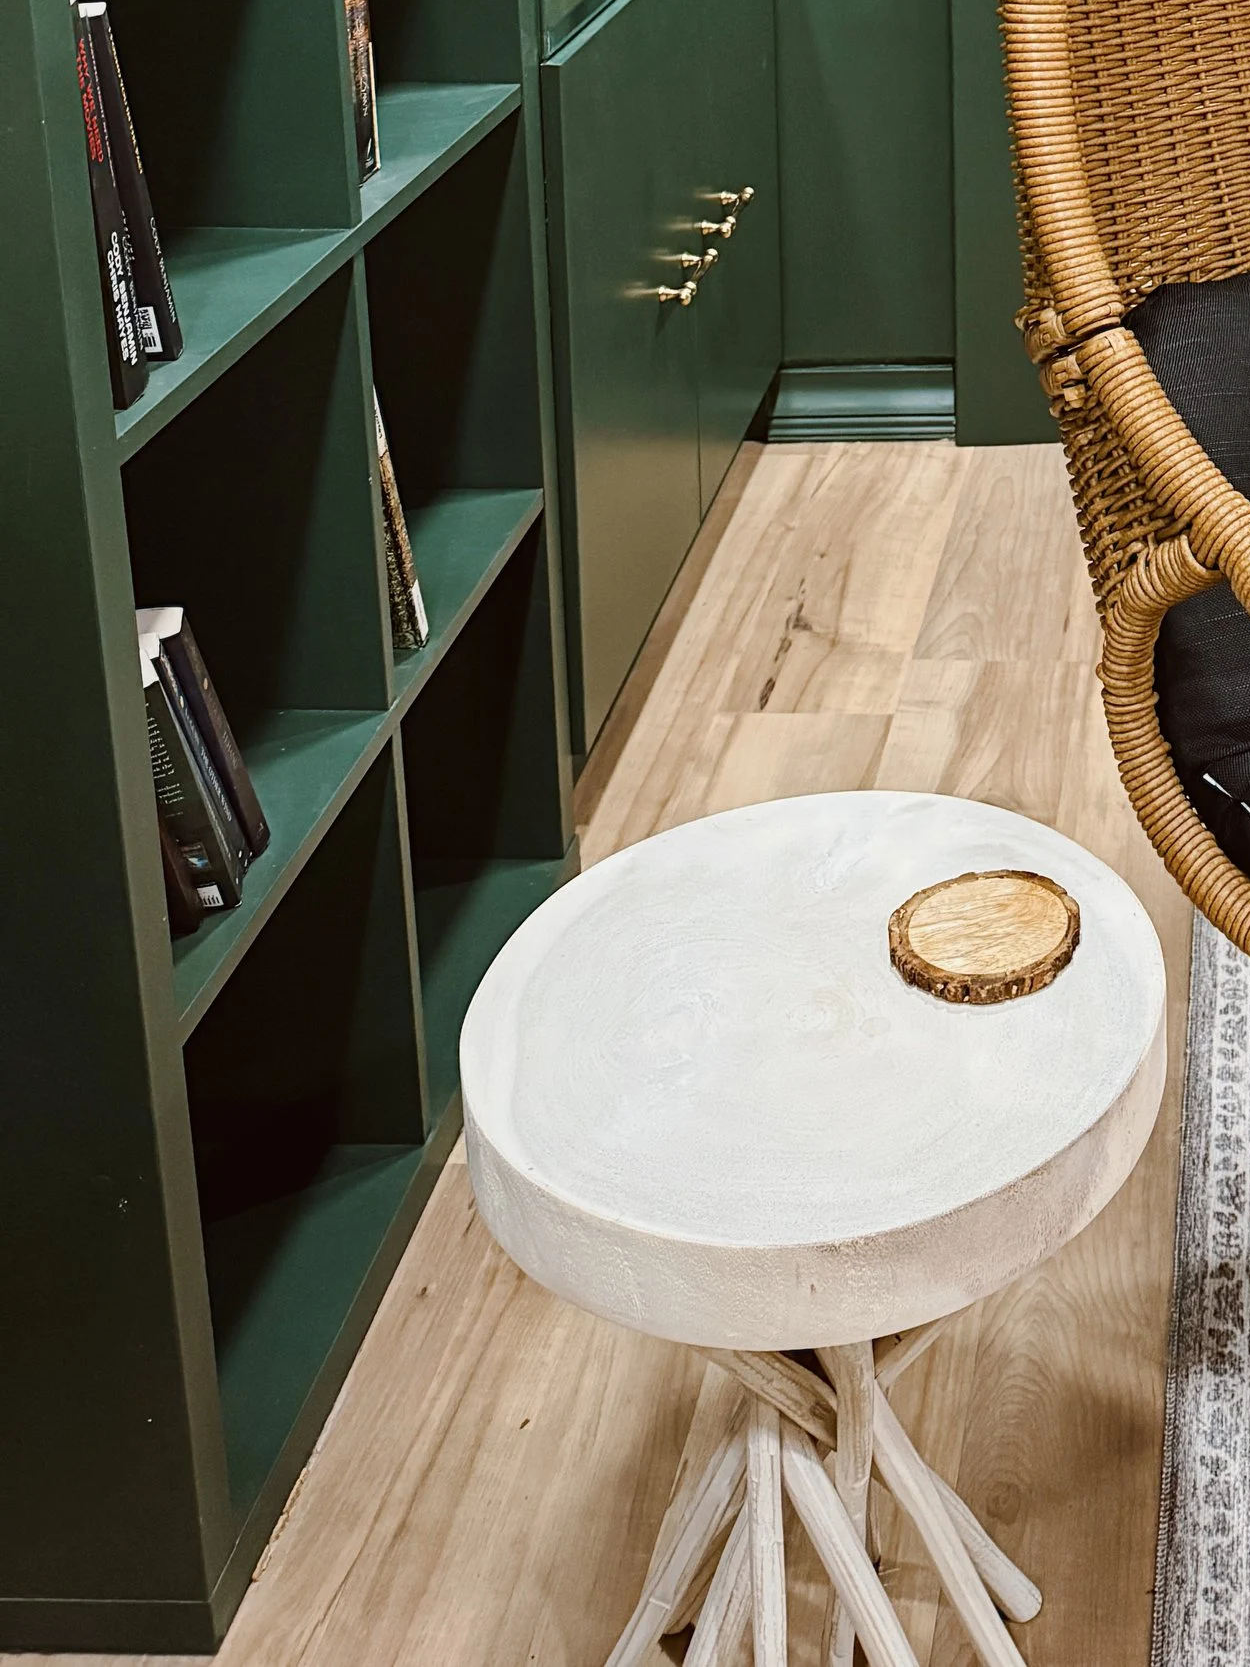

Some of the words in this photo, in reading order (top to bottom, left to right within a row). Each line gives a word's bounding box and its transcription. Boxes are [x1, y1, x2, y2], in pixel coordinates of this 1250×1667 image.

[79, 37, 91, 77] WHY
[91, 115, 105, 163] NEED
[107, 249, 121, 303] CHRIS
[115, 304, 130, 362] HAYES
[111, 231, 125, 276] CODY
[118, 280, 139, 367] BENJAMIN
